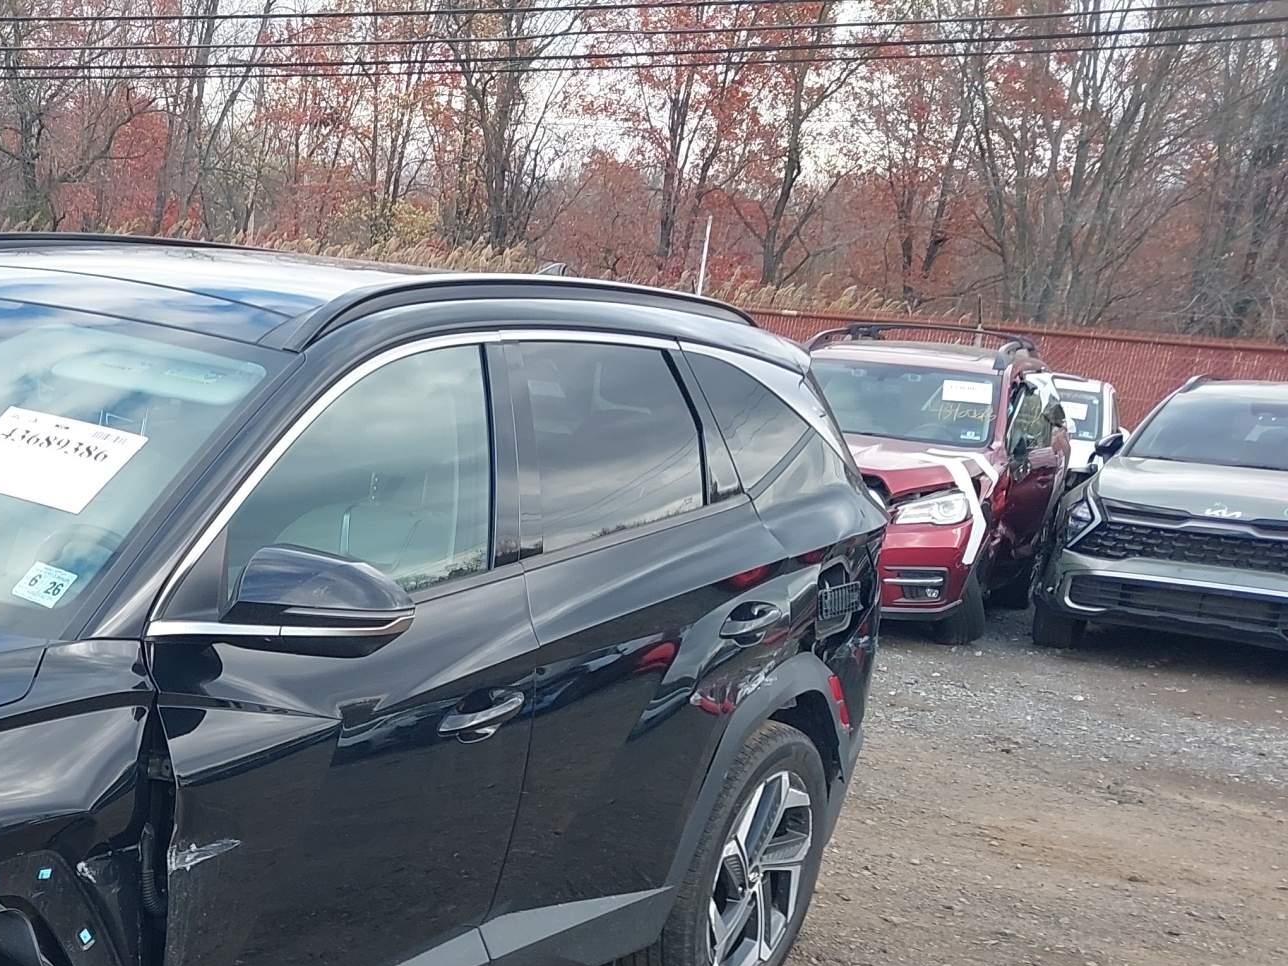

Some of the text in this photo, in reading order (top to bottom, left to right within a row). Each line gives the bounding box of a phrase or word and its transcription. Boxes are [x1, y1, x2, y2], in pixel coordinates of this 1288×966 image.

[0, 427, 108, 462] 43689386
[28, 574, 42, 587] 6
[43, 581, 64, 597] 26
